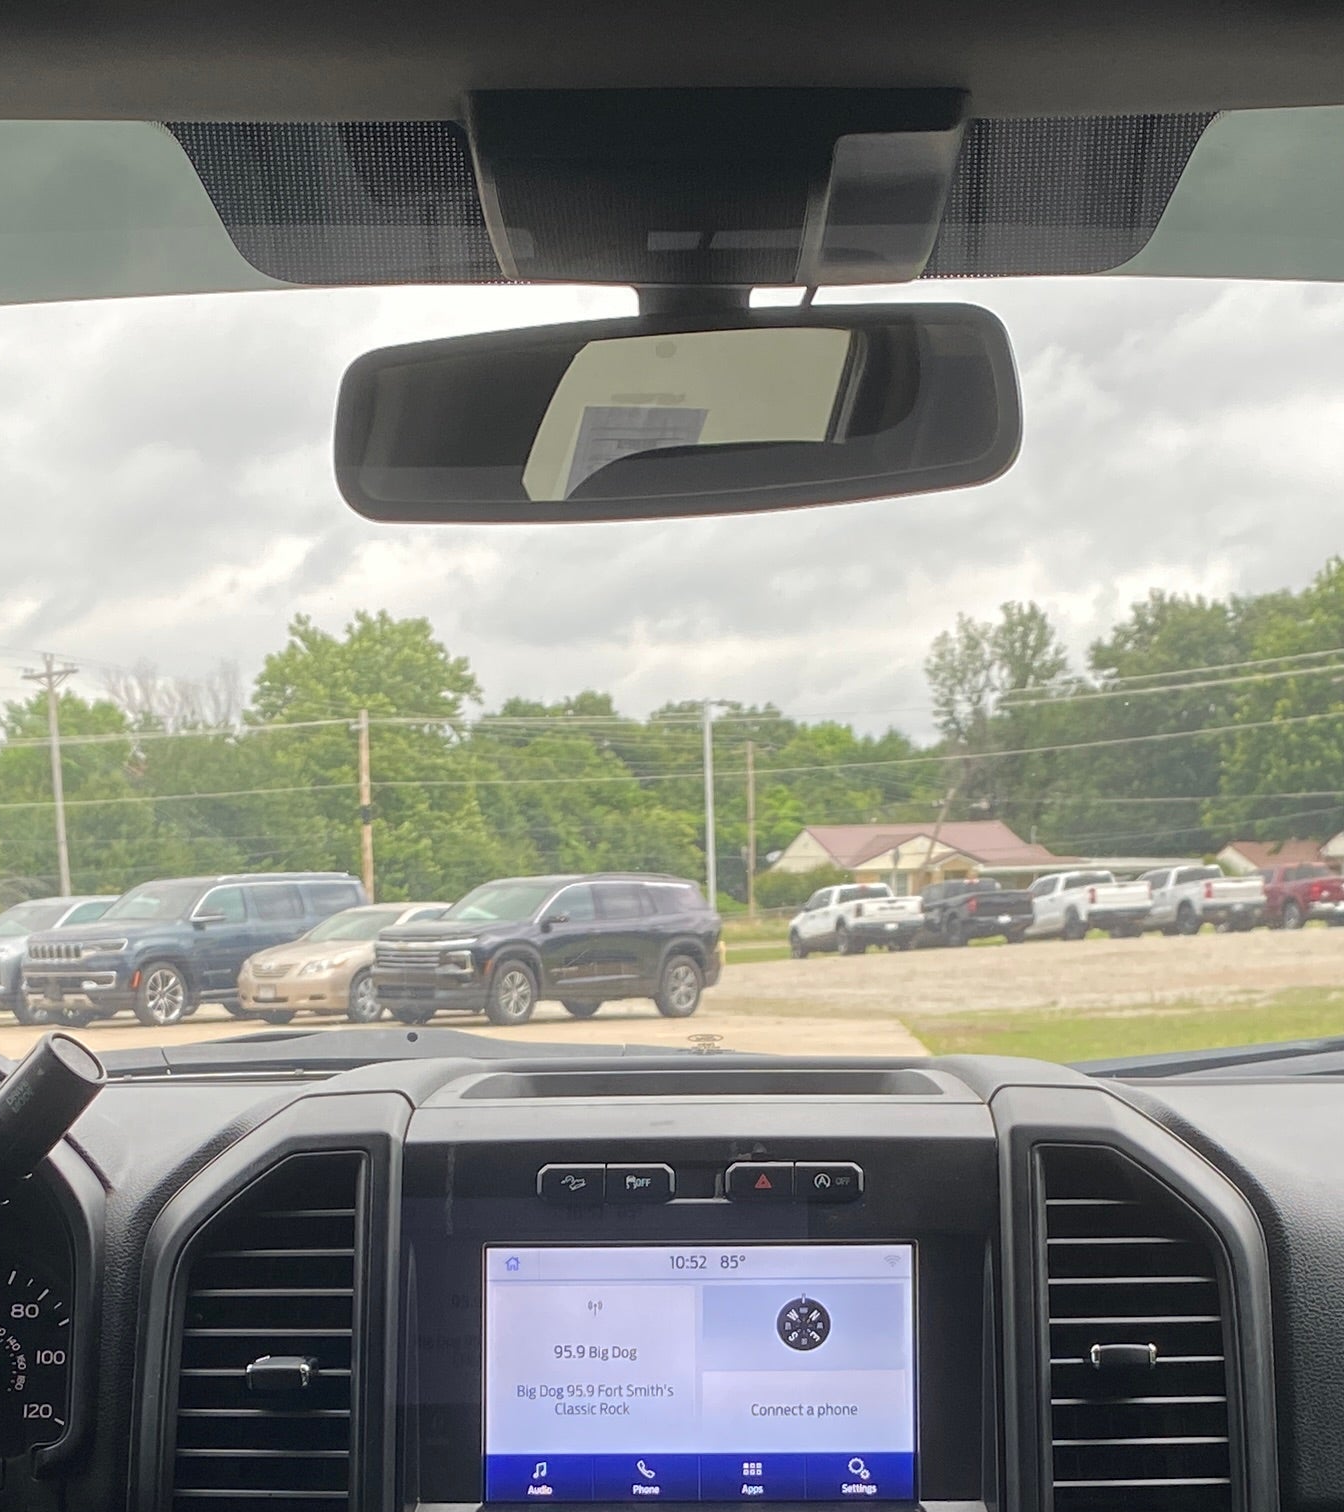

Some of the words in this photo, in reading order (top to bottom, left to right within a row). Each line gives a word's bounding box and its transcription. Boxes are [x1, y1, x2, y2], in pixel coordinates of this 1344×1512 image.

[669, 1255, 707, 1270] 10:52
[720, 1255, 746, 1270] 85°
[10, 1303, 39, 1319] 80
[36, 1350, 66, 1365] 100
[554, 1345, 585, 1359] 95.9
[589, 1345, 609, 1361] Big
[612, 1346, 638, 1361] Dog
[517, 1384, 536, 1400] Big
[539, 1384, 564, 1400] Dog
[567, 1384, 595, 1398] 95.9
[598, 1384, 623, 1398] Fort
[626, 1383, 674, 1398] Smith's
[23, 1403, 53, 1419] 120
[554, 1402, 597, 1415] Classic
[600, 1402, 630, 1415] Rock
[751, 1403, 804, 1416] Connect
[806, 1405, 814, 1416] a
[817, 1402, 858, 1419] phone
[527, 1483, 553, 1495] Audio
[632, 1483, 660, 1495] Phone
[741, 1483, 764, 1497] Apps
[841, 1481, 877, 1497] Settings
